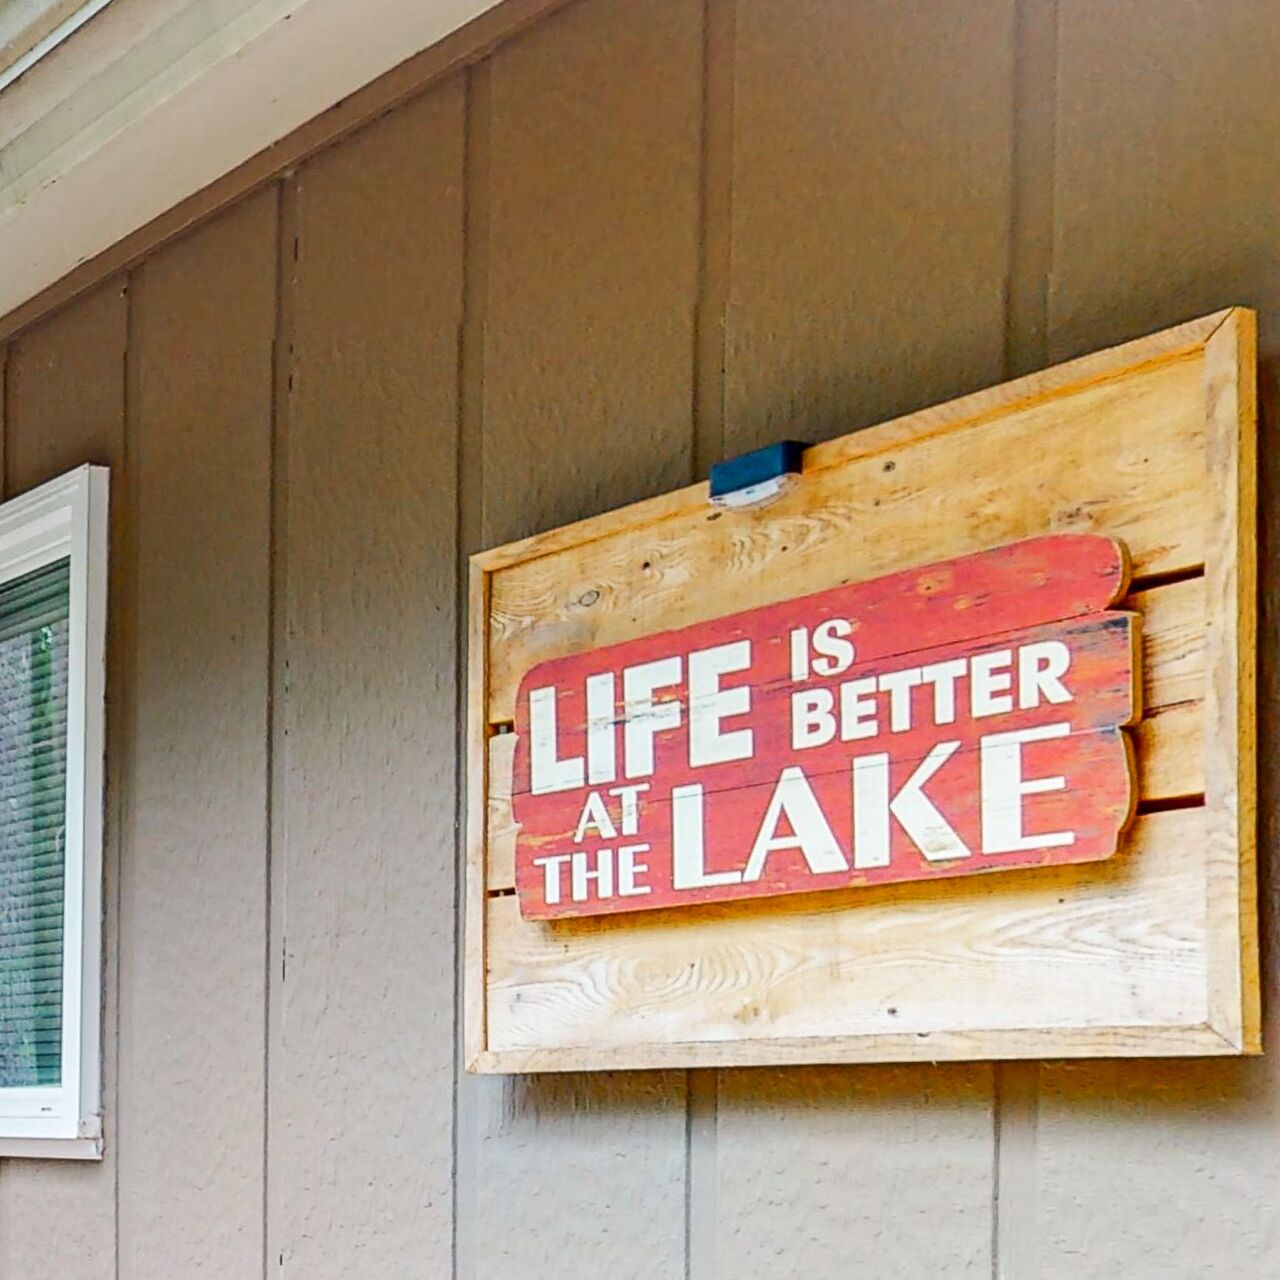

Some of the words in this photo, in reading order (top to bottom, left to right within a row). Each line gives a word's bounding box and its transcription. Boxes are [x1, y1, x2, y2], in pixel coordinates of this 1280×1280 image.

[528, 639, 754, 795] LIFE
[789, 618, 855, 683] IS
[791, 641, 1073, 751] BETTER
[533, 844, 651, 905] THE
[671, 721, 1076, 890] LAKE
[572, 783, 650, 844] AT
